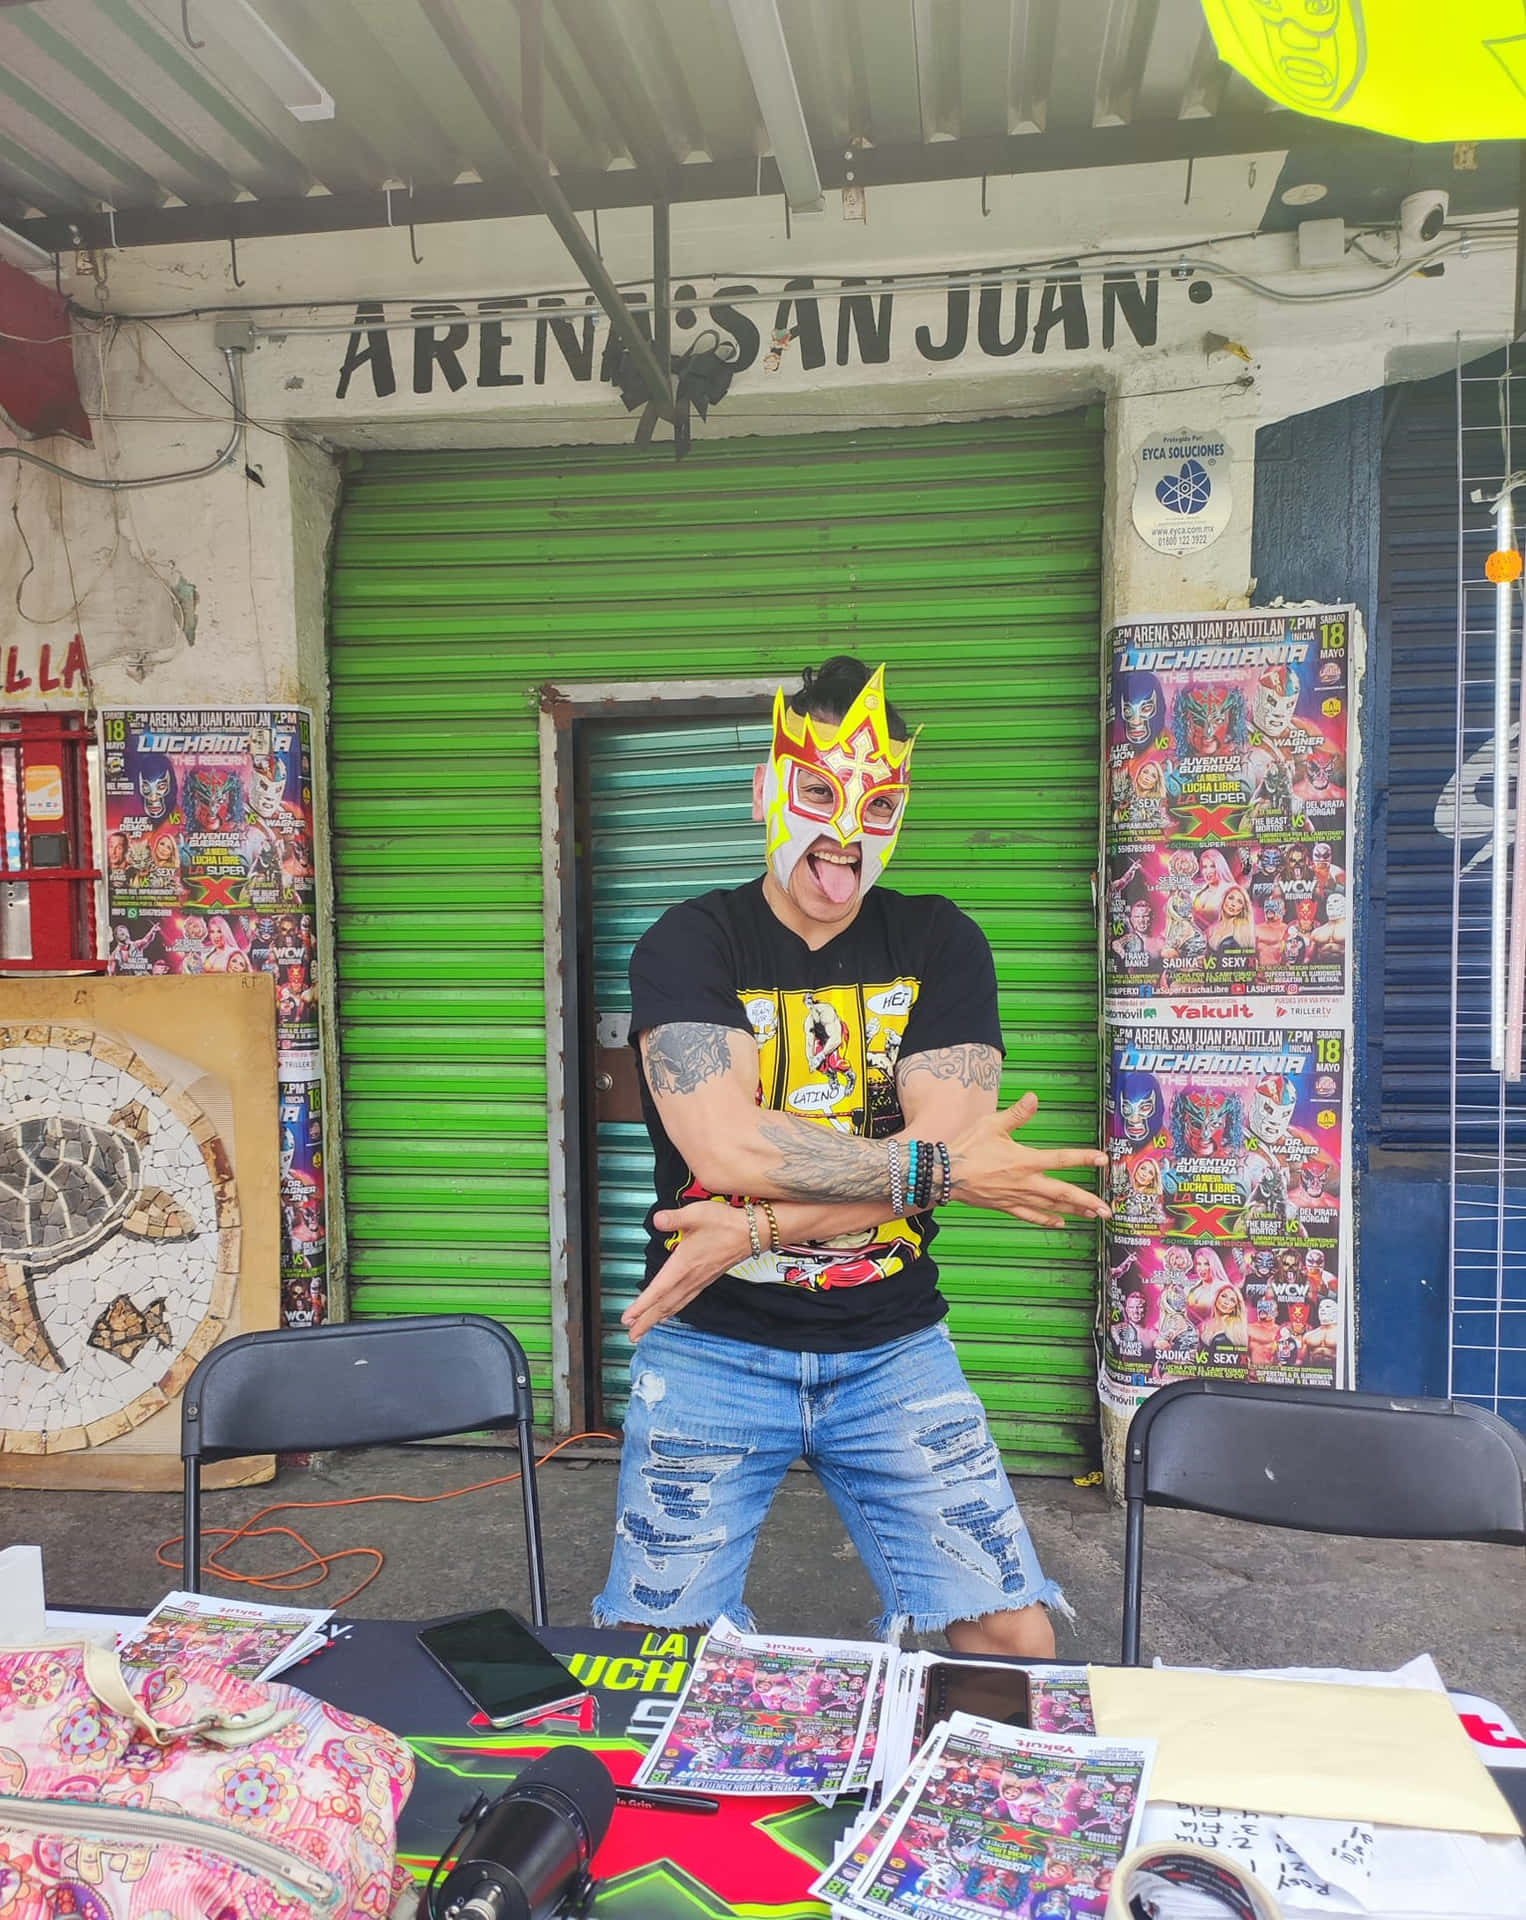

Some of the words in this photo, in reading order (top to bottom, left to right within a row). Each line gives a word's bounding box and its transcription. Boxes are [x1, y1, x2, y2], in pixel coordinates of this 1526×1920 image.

[708, 277, 894, 374] SAN
[915, 261, 1160, 361] JUAN
[1142, 447, 1166, 461] EYCA
[1168, 443, 1225, 459] SOLUCIONES
[1133, 624, 1170, 644] ARENA
[1171, 622, 1195, 641] SAN
[1196, 621, 1223, 640] JUAN
[1225, 618, 1286, 639] PANTITLAN
[1291, 631, 1315, 641] INICIA
[1320, 622, 1345, 649] 18
[1119, 643, 1309, 673] LUCHAMANIA
[1320, 647, 1345, 659] MAYO
[150, 712, 178, 727] ARENA
[180, 712, 199, 727] SAN
[200, 712, 223, 728] JUAN
[224, 712, 271, 728] PANTITLAN
[105, 719, 125, 742] 18
[1289, 730, 1308, 738] DR.
[1154, 736, 1169, 750] VS
[1247, 731, 1262, 746] VS
[1273, 737, 1325, 746] WAGNER
[105, 742, 126, 750] MAYO
[1180, 756, 1241, 766] JUVENTUD
[1179, 764, 1242, 774] GUERRERA
[1182, 783, 1213, 793] LUCHA
[1215, 782, 1241, 792] LIBRE
[1139, 799, 1161, 808] SEXY
[1177, 795, 1197, 805] LA
[1199, 792, 1246, 804] SUPER
[1319, 800, 1345, 809] PIRATA
[1305, 807, 1336, 816] MORGAN
[168, 812, 181, 825] VS
[1265, 816, 1288, 826] BEAST
[1291, 814, 1305, 828] VS
[188, 866, 204, 875] LA
[206, 865, 246, 875] SUPER
[1279, 879, 1317, 893] WCW
[1112, 921, 1125, 937] VS
[274, 948, 305, 958] WCW
[1162, 958, 1199, 969] SADIKA
[1203, 955, 1217, 970] VS
[1221, 956, 1247, 968] SEXY
[1171, 1004, 1254, 1019] Yakult
[1135, 1028, 1169, 1045] ARENA
[1171, 1028, 1193, 1045] SAN
[1195, 1028, 1222, 1047] JUAN
[1225, 1029, 1283, 1047] PANTITLAN
[1289, 1044, 1312, 1053] INICIA
[1316, 1039, 1341, 1063] 18
[1120, 1051, 1307, 1074] LUCHAMANIA
[1316, 1062, 1340, 1072] MAYO
[308, 1089, 321, 1110] 18
[793, 1084, 840, 1105] LATINO
[1153, 1136, 1167, 1149] VS
[1244, 1137, 1258, 1151] VS
[1285, 1138, 1303, 1146] DR.
[1269, 1145, 1320, 1154] WAGNER
[1177, 1157, 1237, 1167] JUVENTUD
[1176, 1165, 1238, 1174] GUERRERA
[1179, 1182, 1208, 1193] LUCHA
[1210, 1183, 1236, 1193] LIBRE
[1135, 1194, 1158, 1203] SEXY
[1173, 1193, 1193, 1203] LA
[1195, 1193, 1242, 1204] SUPER
[1313, 1208, 1338, 1217] PIRATA
[1260, 1221, 1282, 1229] BEAST
[1285, 1219, 1299, 1233] VS
[1300, 1215, 1330, 1224] MORGAN
[293, 1252, 305, 1265] VS
[1271, 1282, 1310, 1297] WCW
[285, 1310, 315, 1321] WCW
[1155, 1350, 1191, 1360] SADIKA
[1195, 1348, 1209, 1364] VS
[1213, 1353, 1239, 1364] SEXY
[640, 1632, 688, 1658] LA
[762, 1642, 814, 1655] Yakult
[566, 1653, 690, 1693] UCH
[1015, 1738, 1076, 1755] Yakult
[675, 1771, 815, 1785] LUCHAMANIA
[825, 1880, 849, 1896] 18
[869, 1887, 892, 1903] 18
